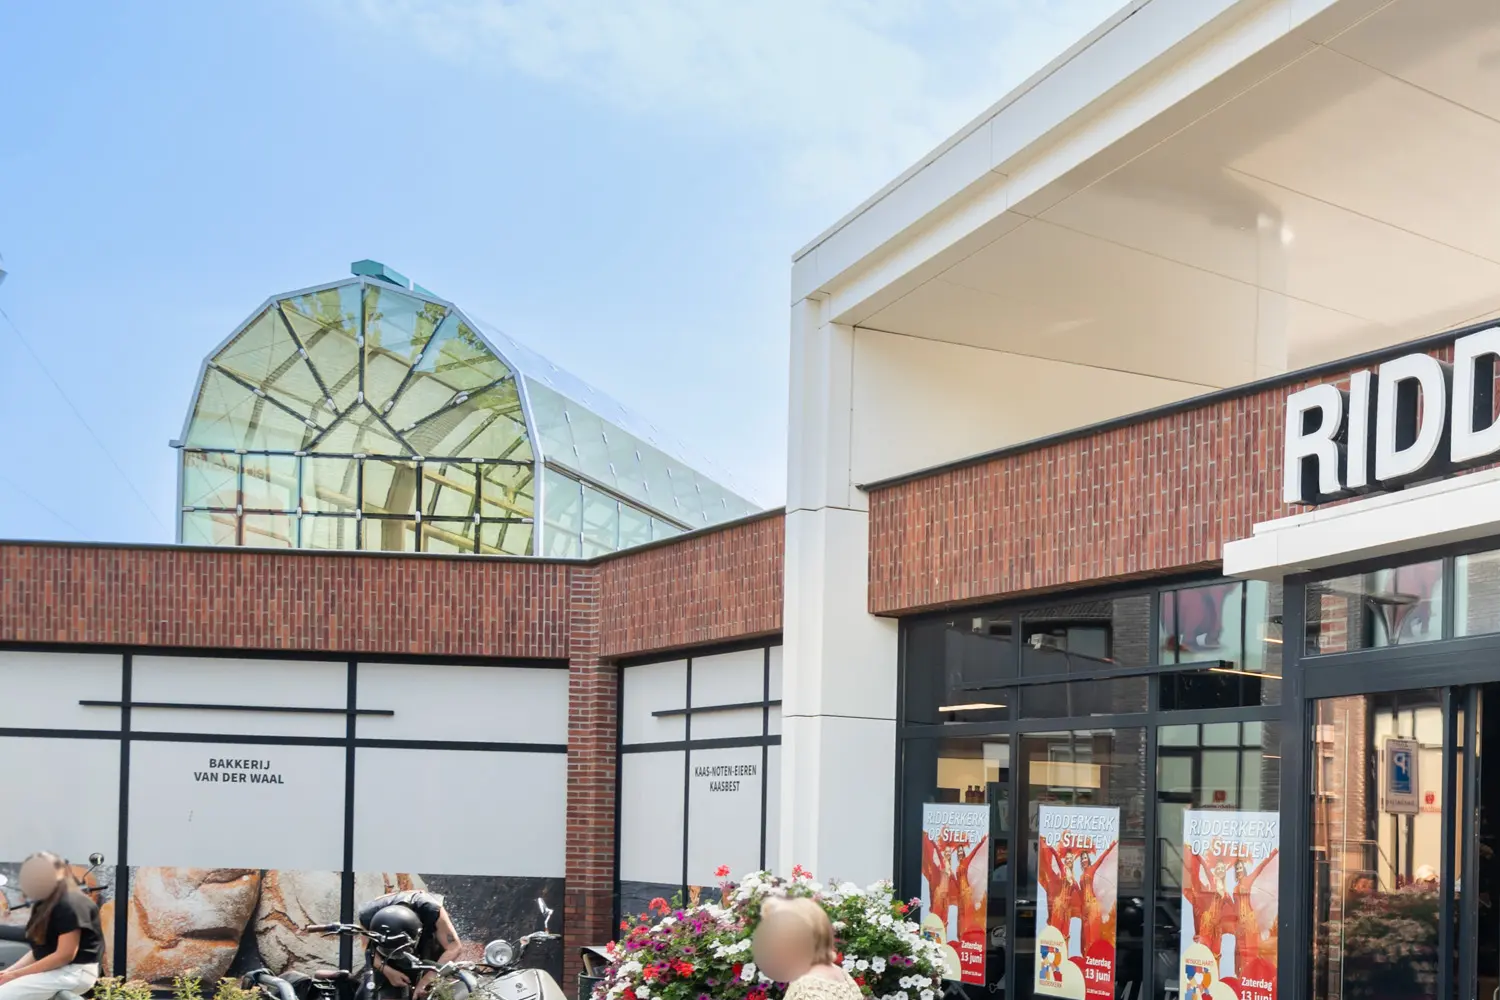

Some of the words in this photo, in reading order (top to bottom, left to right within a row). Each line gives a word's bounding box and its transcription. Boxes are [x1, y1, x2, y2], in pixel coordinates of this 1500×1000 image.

[209, 758, 270, 770] BAKKERIJ
[194, 772, 218, 782] VAN
[222, 772, 247, 783] DER
[250, 773, 284, 784] WAAL
[710, 781, 740, 792] KAASBEST
[926, 811, 986, 827] RIDDERKERK
[1044, 813, 1115, 831] RIDDERKERK
[928, 827, 942, 841] OP
[942, 829, 983, 843] STELTEN
[1189, 819, 1276, 838] RIDDERKERK
[1046, 832, 1060, 847] OP
[1063, 833, 1112, 849] STELTEN
[1191, 840, 1210, 856] OP
[1212, 840, 1272, 858] STELTEN
[960, 952, 969, 962] 13
[970, 953, 982, 965] juni
[1086, 956, 1111, 969] Zaterdag
[1085, 968, 1094, 979] 13
[1096, 970, 1110, 982] juni
[1241, 977, 1272, 992] Zaterdag
